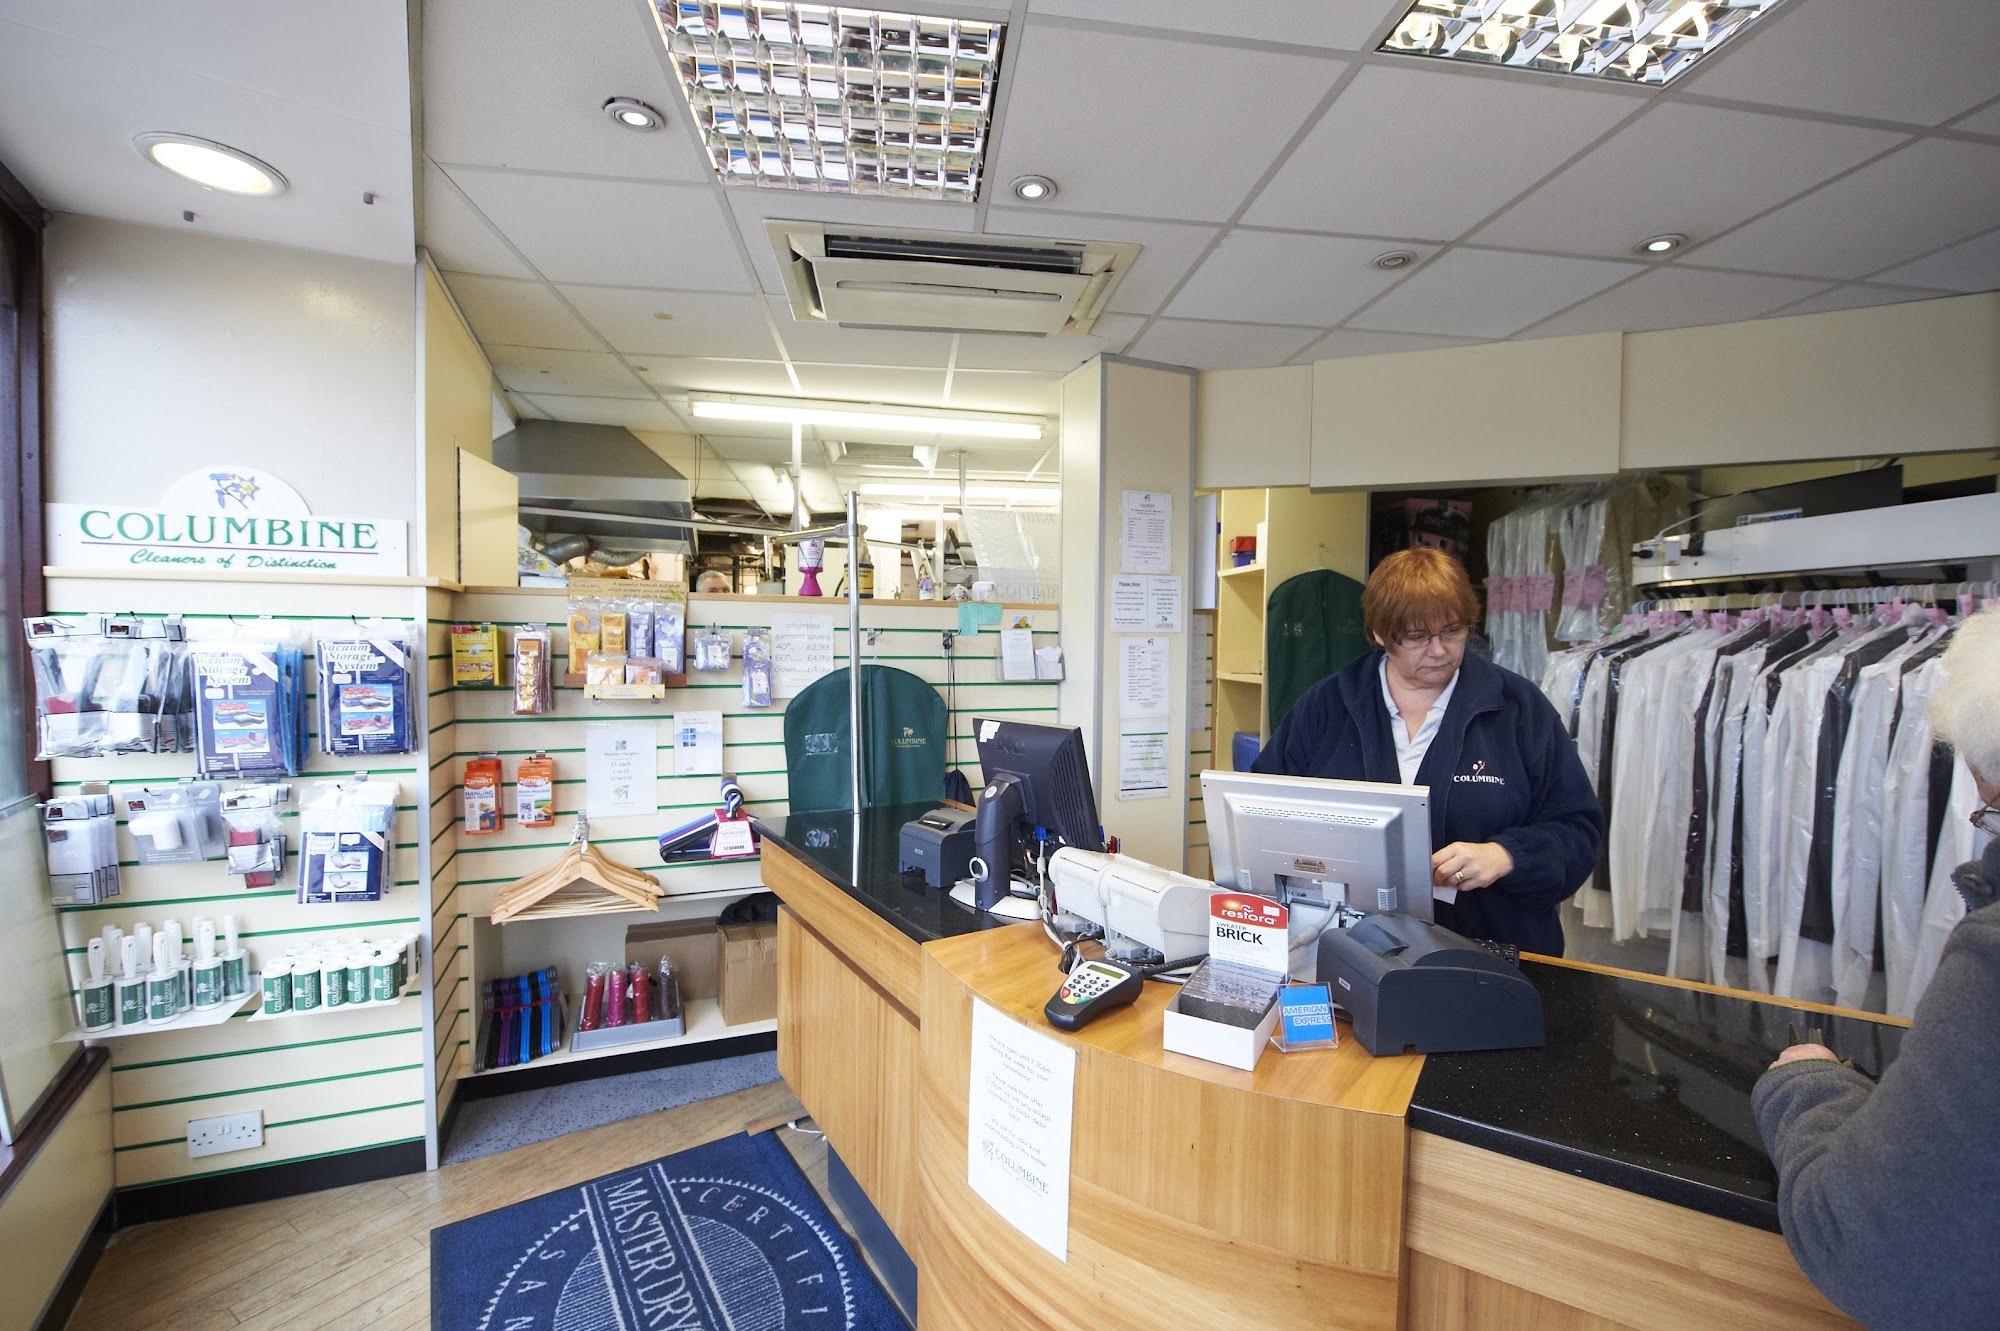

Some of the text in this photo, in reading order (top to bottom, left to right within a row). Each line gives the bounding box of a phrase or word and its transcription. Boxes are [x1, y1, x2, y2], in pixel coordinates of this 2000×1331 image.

[79, 510, 378, 549] COLUMBINE
[216, 554, 236, 569] of
[247, 555, 338, 570] Distinction
[774, 633, 805, 642] garment
[321, 643, 369, 652] Vacuum
[806, 643, 830, 651] £2.99
[328, 652, 374, 662] Storage
[201, 664, 246, 677] Storage
[335, 661, 377, 673] System
[209, 675, 250, 687] System
[465, 777, 494, 785] Zensect
[519, 776, 549, 784] Zensect
[1453, 774, 1506, 786] COLUMBINE
[1221, 909, 1275, 925] restora
[1216, 921, 1247, 931] SWEATER
[1216, 926, 1264, 946] BRICK
[1284, 1004, 1327, 1015] AMERICAN
[1295, 1016, 1332, 1026] EXPRESS
[1033, 1109, 1051, 1123] accept
[995, 1148, 1049, 1194] COLUMBINE
[604, 1177, 677, 1283] MASTER
